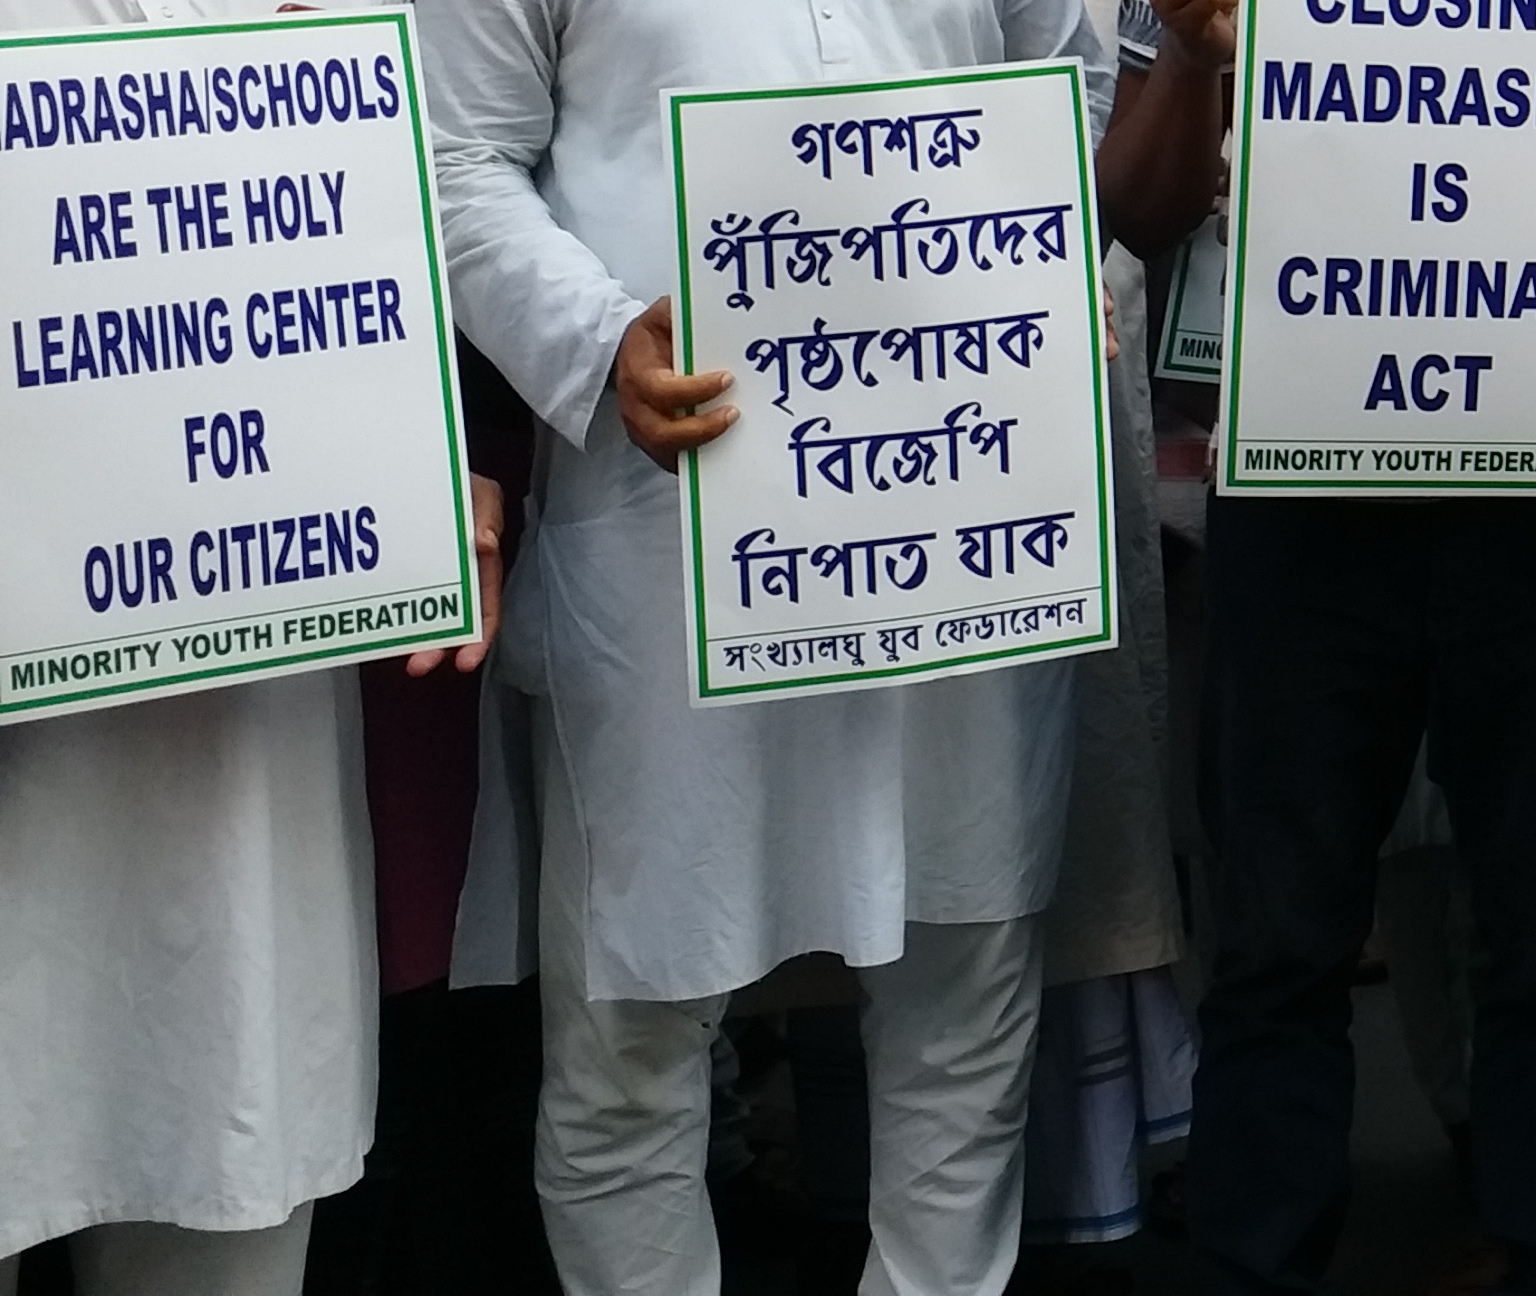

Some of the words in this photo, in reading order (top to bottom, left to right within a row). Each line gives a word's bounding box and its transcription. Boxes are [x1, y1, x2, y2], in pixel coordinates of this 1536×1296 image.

[0, 54, 399, 151] ADRASHA/SCHOOLS
[53, 191, 138, 265] ARE
[147, 181, 233, 254] THE
[242, 171, 345, 245] HOLY
[1410, 163, 1469, 222] IS
[703, 199, 1073, 312] পুঁজিপতিদের
[13, 297, 233, 388] LEARNING
[246, 278, 406, 359] CENTER
[745, 311, 1049, 415] পৃষ্ঠপোষক
[1364, 354, 1492, 411] ACT
[184, 409, 270, 482] FOR
[788, 402, 1018, 499] বিজেপি
[1244, 449, 1363, 472] MINORITY
[1372, 450, 1452, 473] YOUTH
[84, 536, 177, 613] OUR
[189, 506, 380, 597] CITIZENS
[733, 529, 937, 608] নিপাত
[956, 511, 1075, 579] যাক
[10, 641, 162, 691] MINORITY
[171, 618, 274, 664] YOUTH
[283, 593, 459, 645] FEDERATION
[724, 632, 866, 673] সংখ্যালঘু
[878, 626, 923, 662] যুব
[935, 597, 1088, 650] ফেডারেশন
